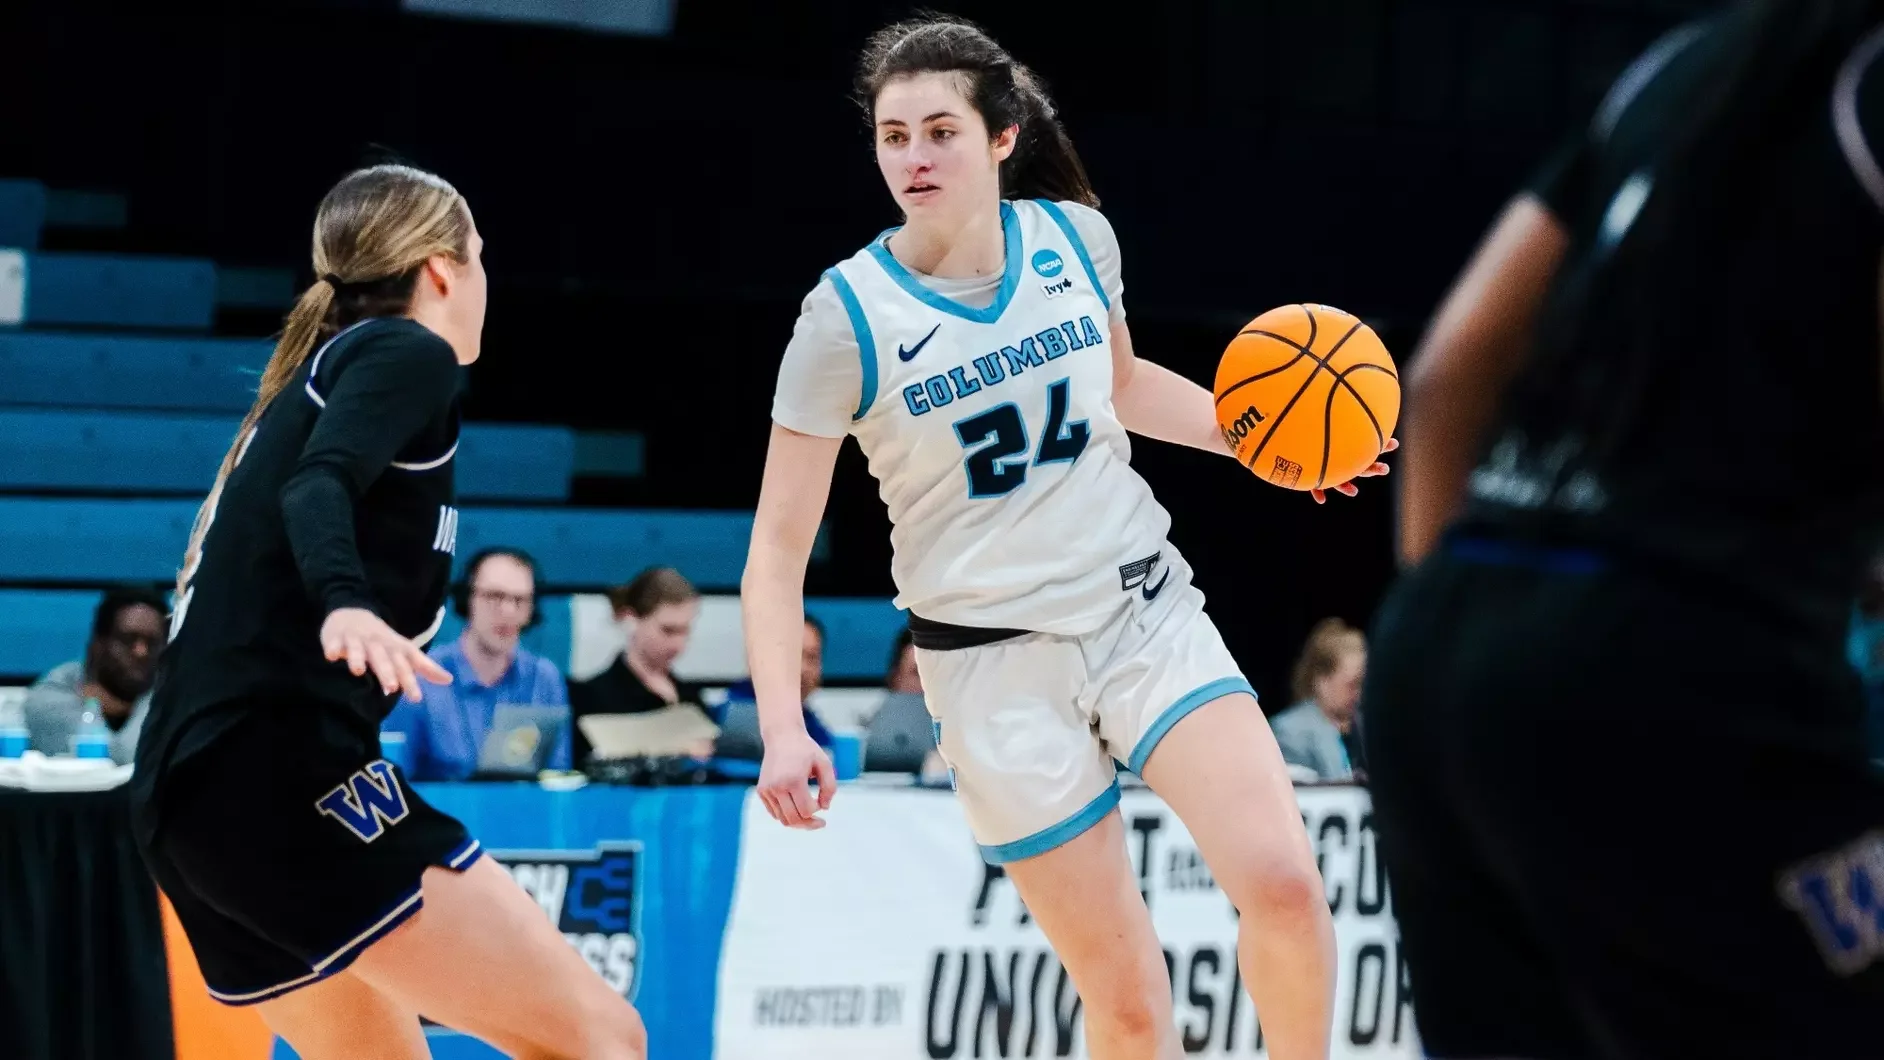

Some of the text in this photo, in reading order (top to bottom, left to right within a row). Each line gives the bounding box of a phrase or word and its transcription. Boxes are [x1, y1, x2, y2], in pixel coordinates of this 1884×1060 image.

[1038, 258, 1062, 273] NCAA
[1044, 282, 1064, 295] Ivy
[903, 315, 1102, 416] COLUMBIA
[951, 376, 1093, 499] 24
[1220, 405, 1265, 455] lson
[315, 759, 409, 844] W
